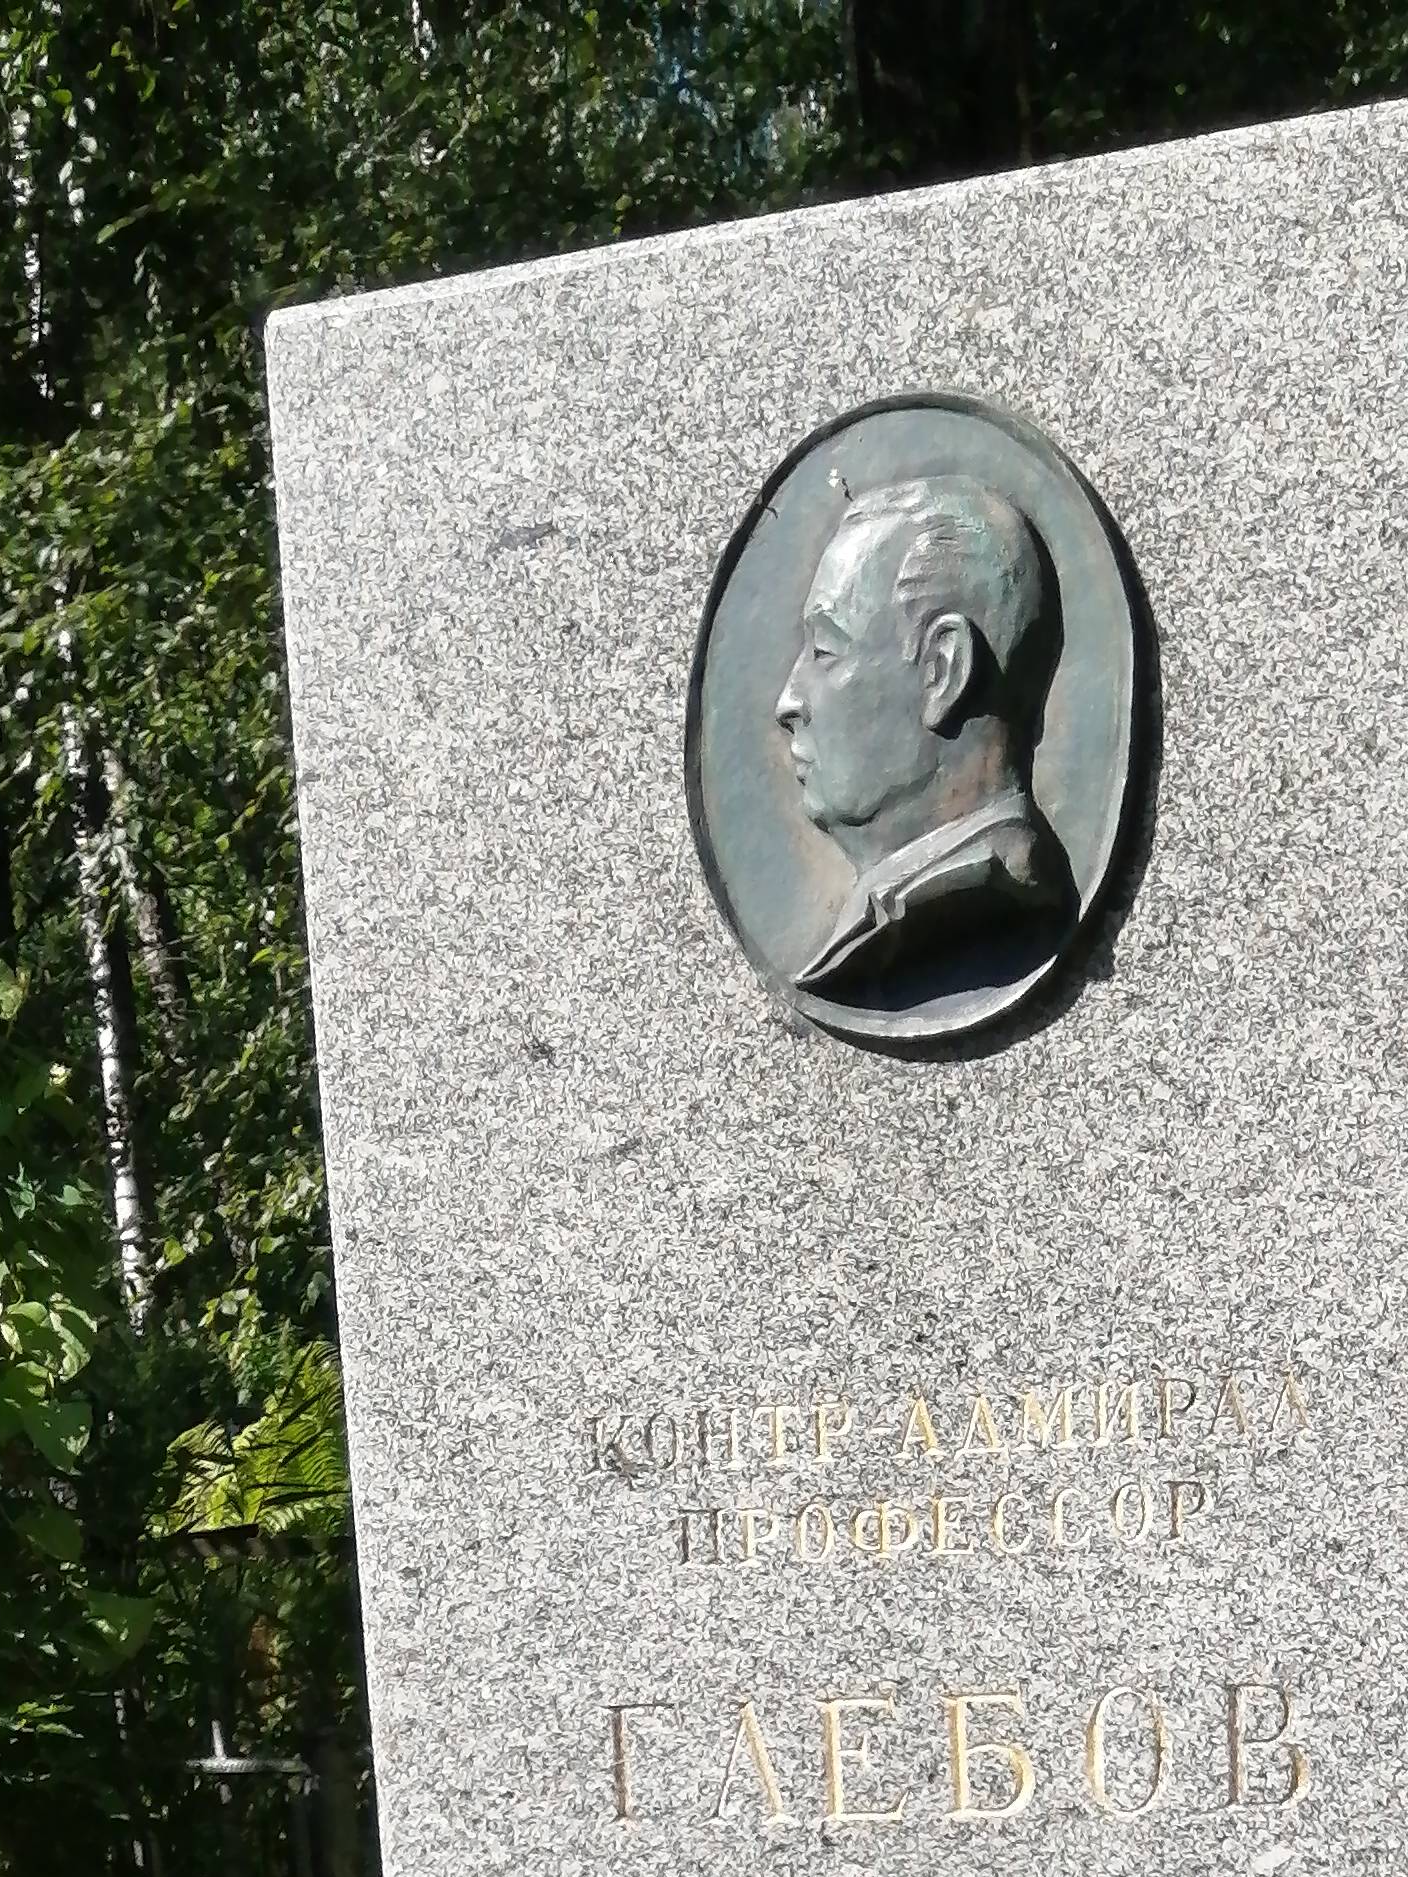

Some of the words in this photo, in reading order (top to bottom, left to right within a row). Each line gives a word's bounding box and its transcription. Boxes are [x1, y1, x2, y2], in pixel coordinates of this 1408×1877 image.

[588, 1372, 1316, 1476] КОНТР-АДМИРАЛ
[678, 1478, 1210, 1567] ПРОФЕССОР
[602, 1682, 1314, 1828] ГЛЕБОВ
